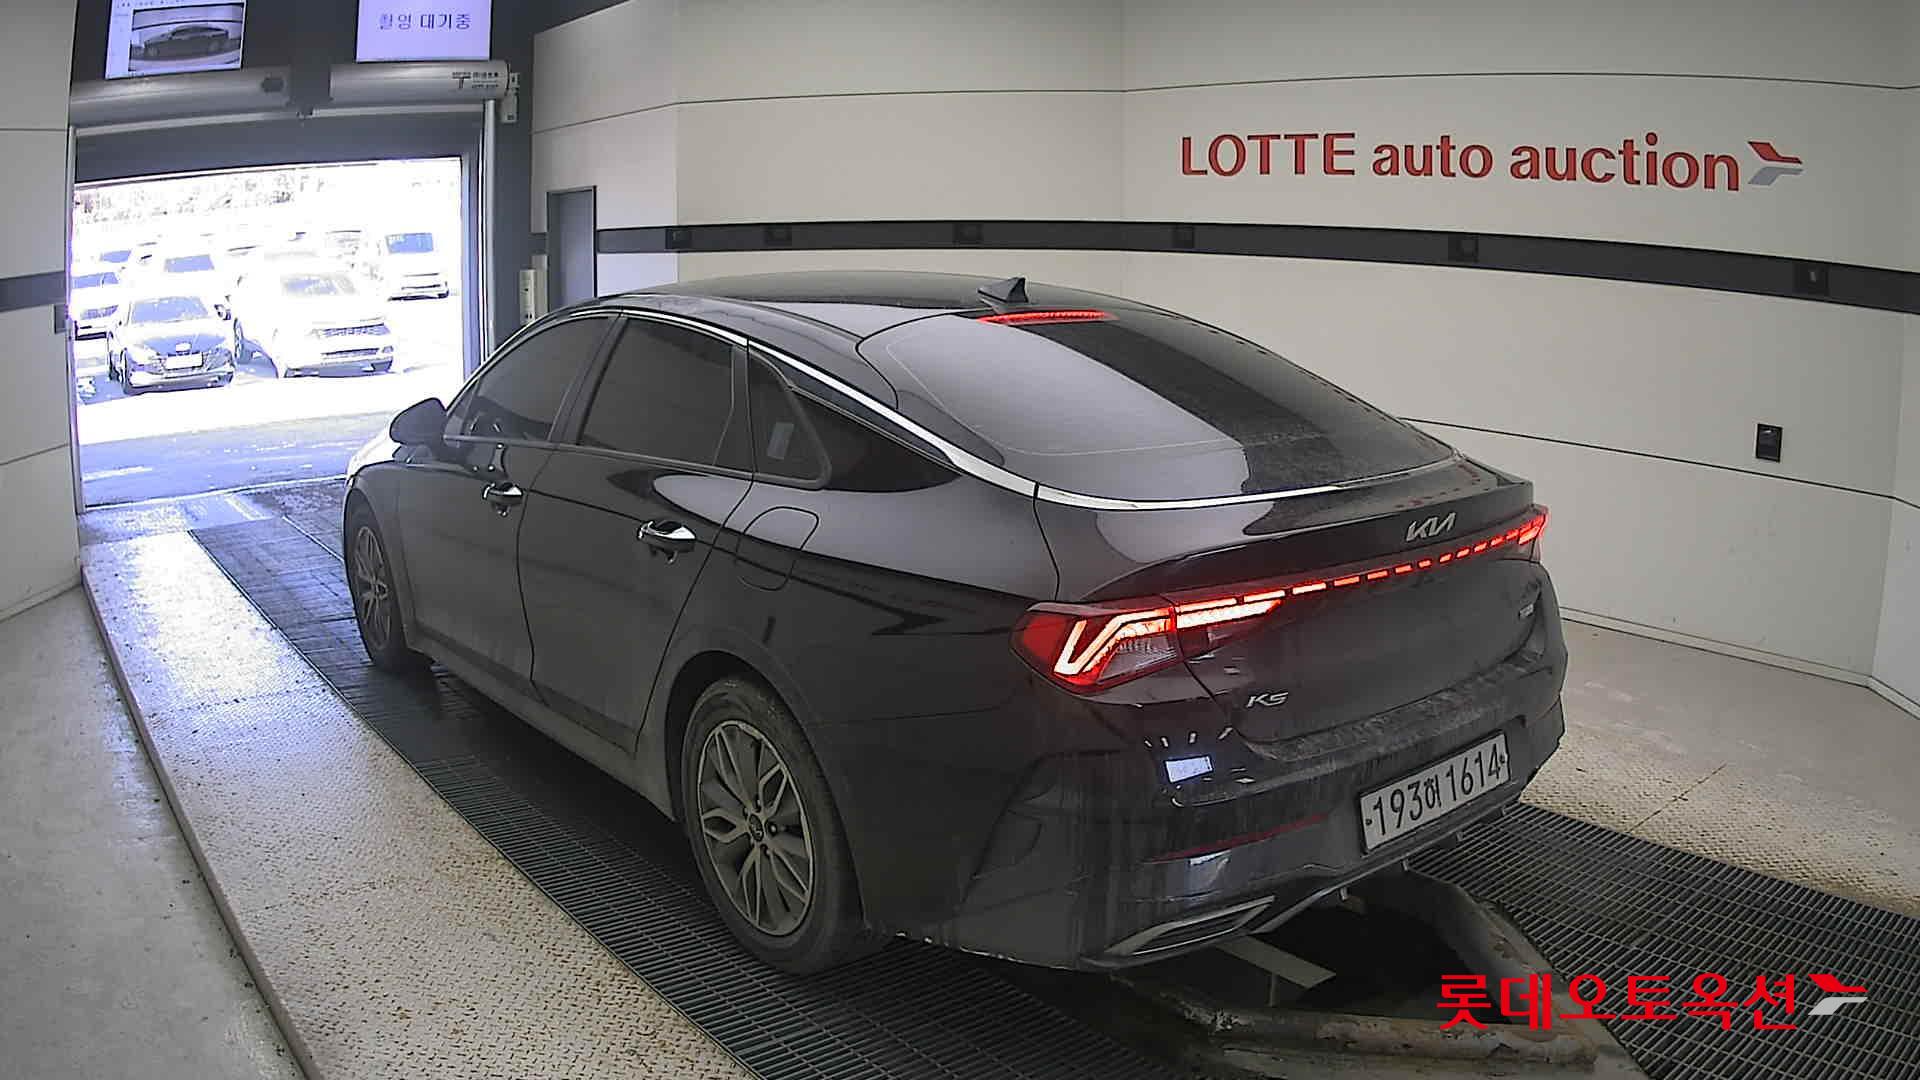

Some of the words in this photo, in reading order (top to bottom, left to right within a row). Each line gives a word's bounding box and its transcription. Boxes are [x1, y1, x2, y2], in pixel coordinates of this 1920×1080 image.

[420, 13, 472, 30] 대기중
[1181, 132, 1357, 178] LOTTE
[1373, 135, 1493, 178] auto
[1510, 132, 1740, 191] auction
[1246, 691, 1289, 708] K5
[1445, 743, 1501, 802] 1614
